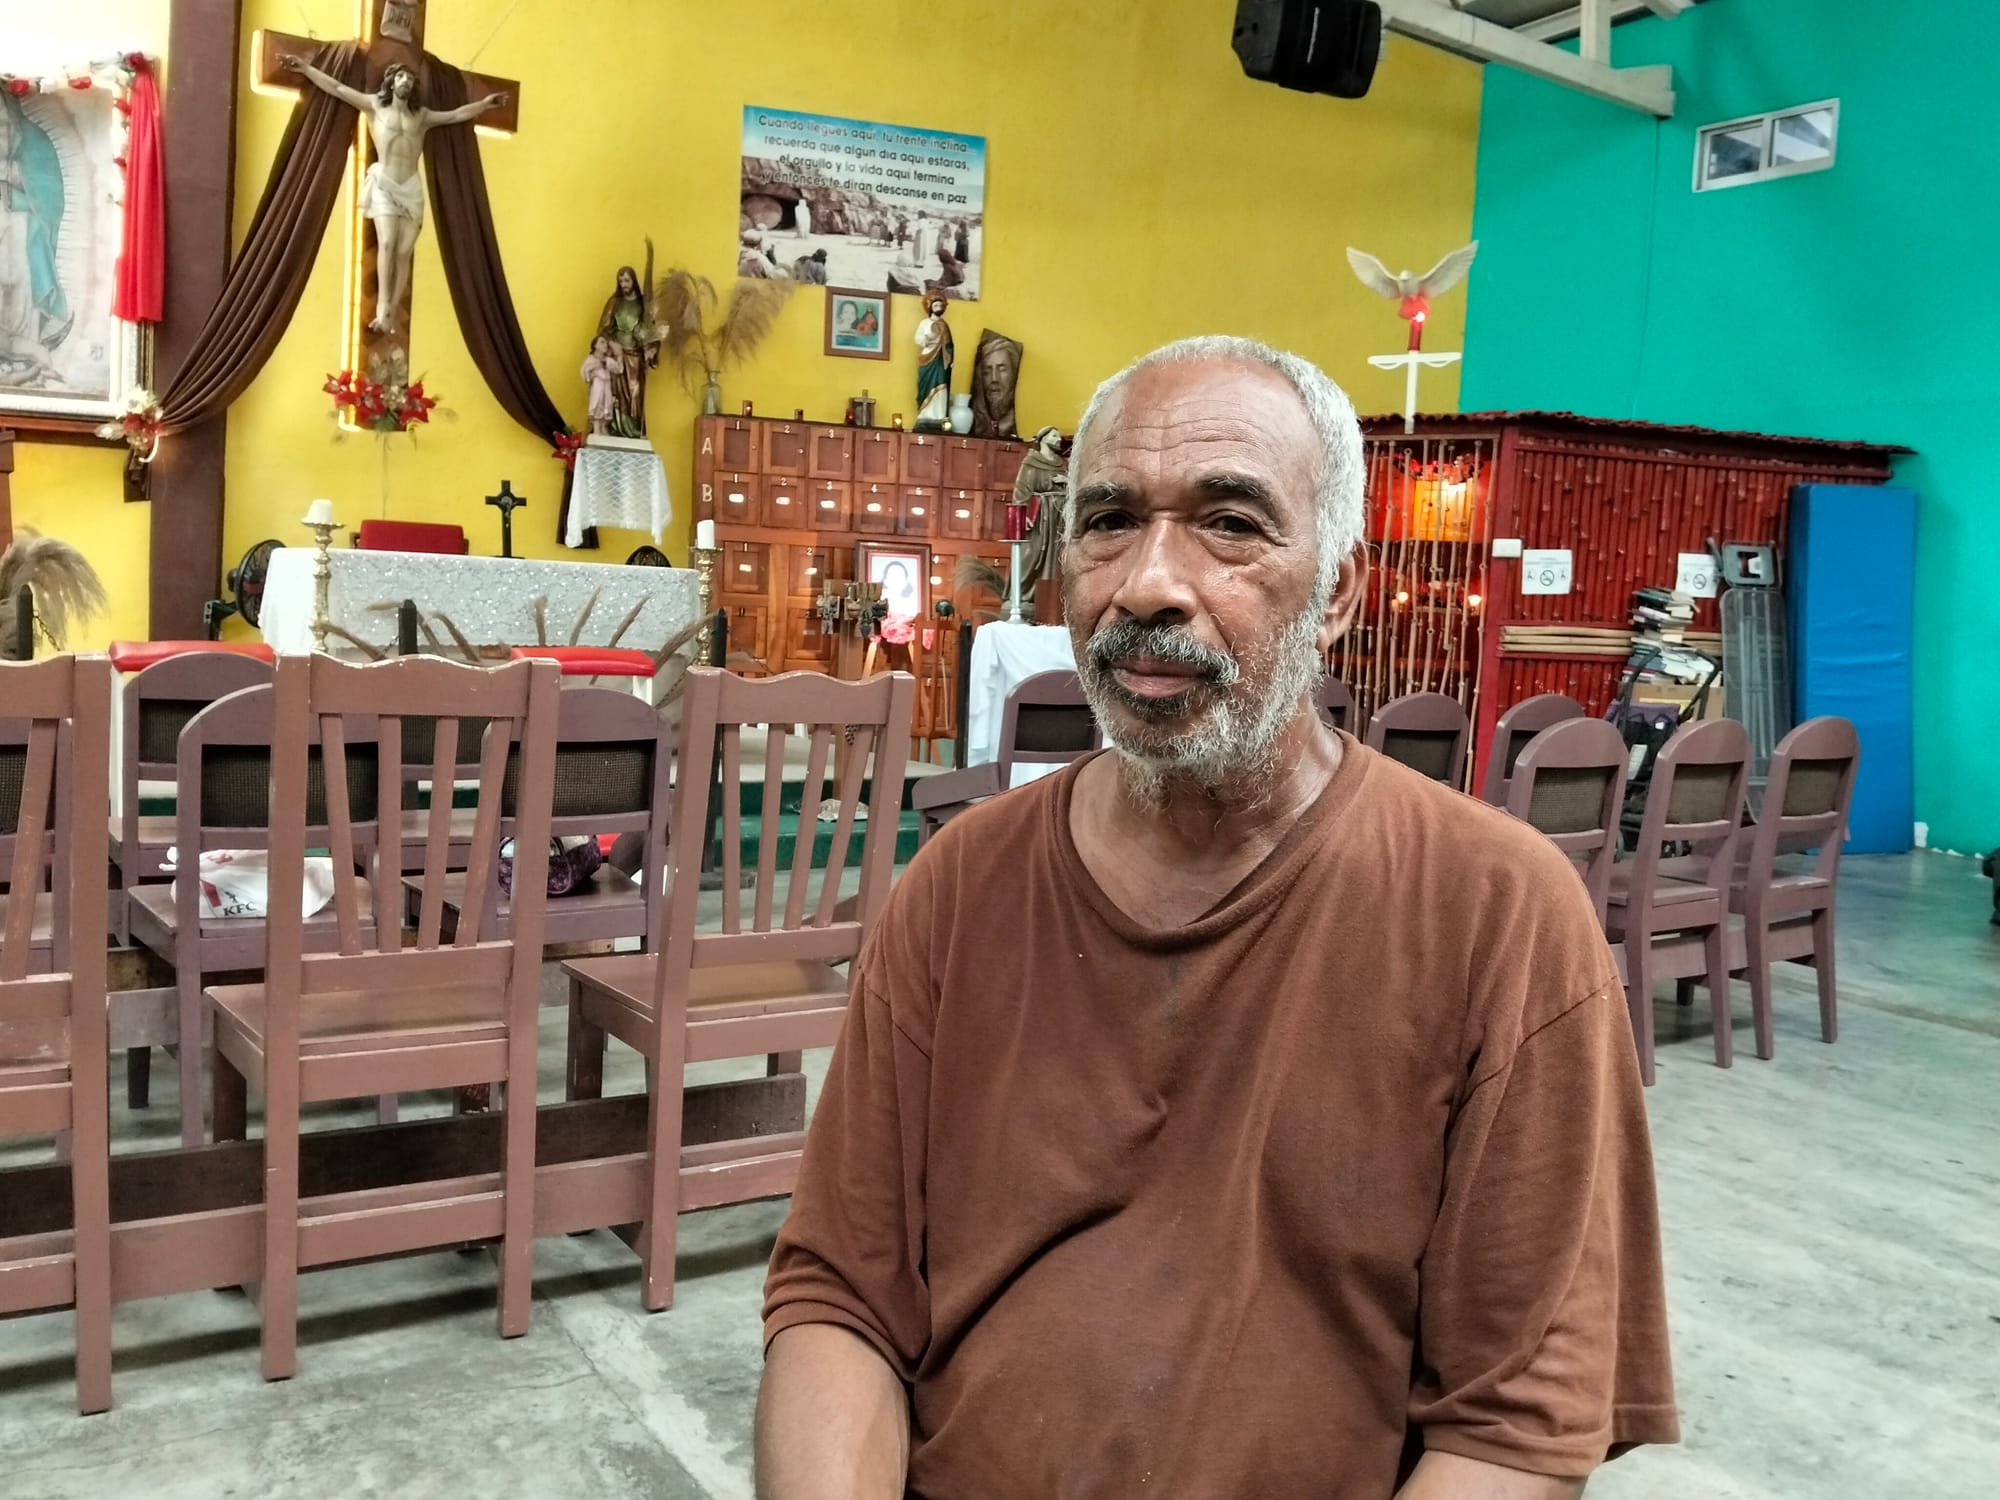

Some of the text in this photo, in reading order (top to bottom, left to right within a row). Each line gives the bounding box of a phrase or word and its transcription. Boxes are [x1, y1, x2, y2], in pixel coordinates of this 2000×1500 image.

[758, 114, 804, 131] Cuando
[807, 121, 847, 137] llegues
[882, 132, 893, 143] tu
[895, 133, 928, 147] frente
[764, 135, 816, 150] recuerda
[819, 142, 841, 154] que
[844, 146, 876, 159] algun
[879, 148, 897, 160] dia
[900, 153, 925, 165] aqui
[779, 153, 955, 185] el orgullo y la vida aqui termina
[774, 171, 826, 187] entonces
[829, 176, 841, 188] te
[843, 179, 872, 192] diran
[875, 182, 928, 200] descanse
[930, 191, 944, 201] en
[947, 193, 967, 205] paz
[784, 424, 791, 434] 2
[828, 428, 835, 439] 3
[702, 437, 713, 455] A
[780, 477, 788, 486] 2
[826, 481, 833, 491] 3
[871, 484, 878, 493] 4
[702, 483, 713, 502] B
[806, 546, 815, 556] 2
[223, 903, 256, 917] KFC
